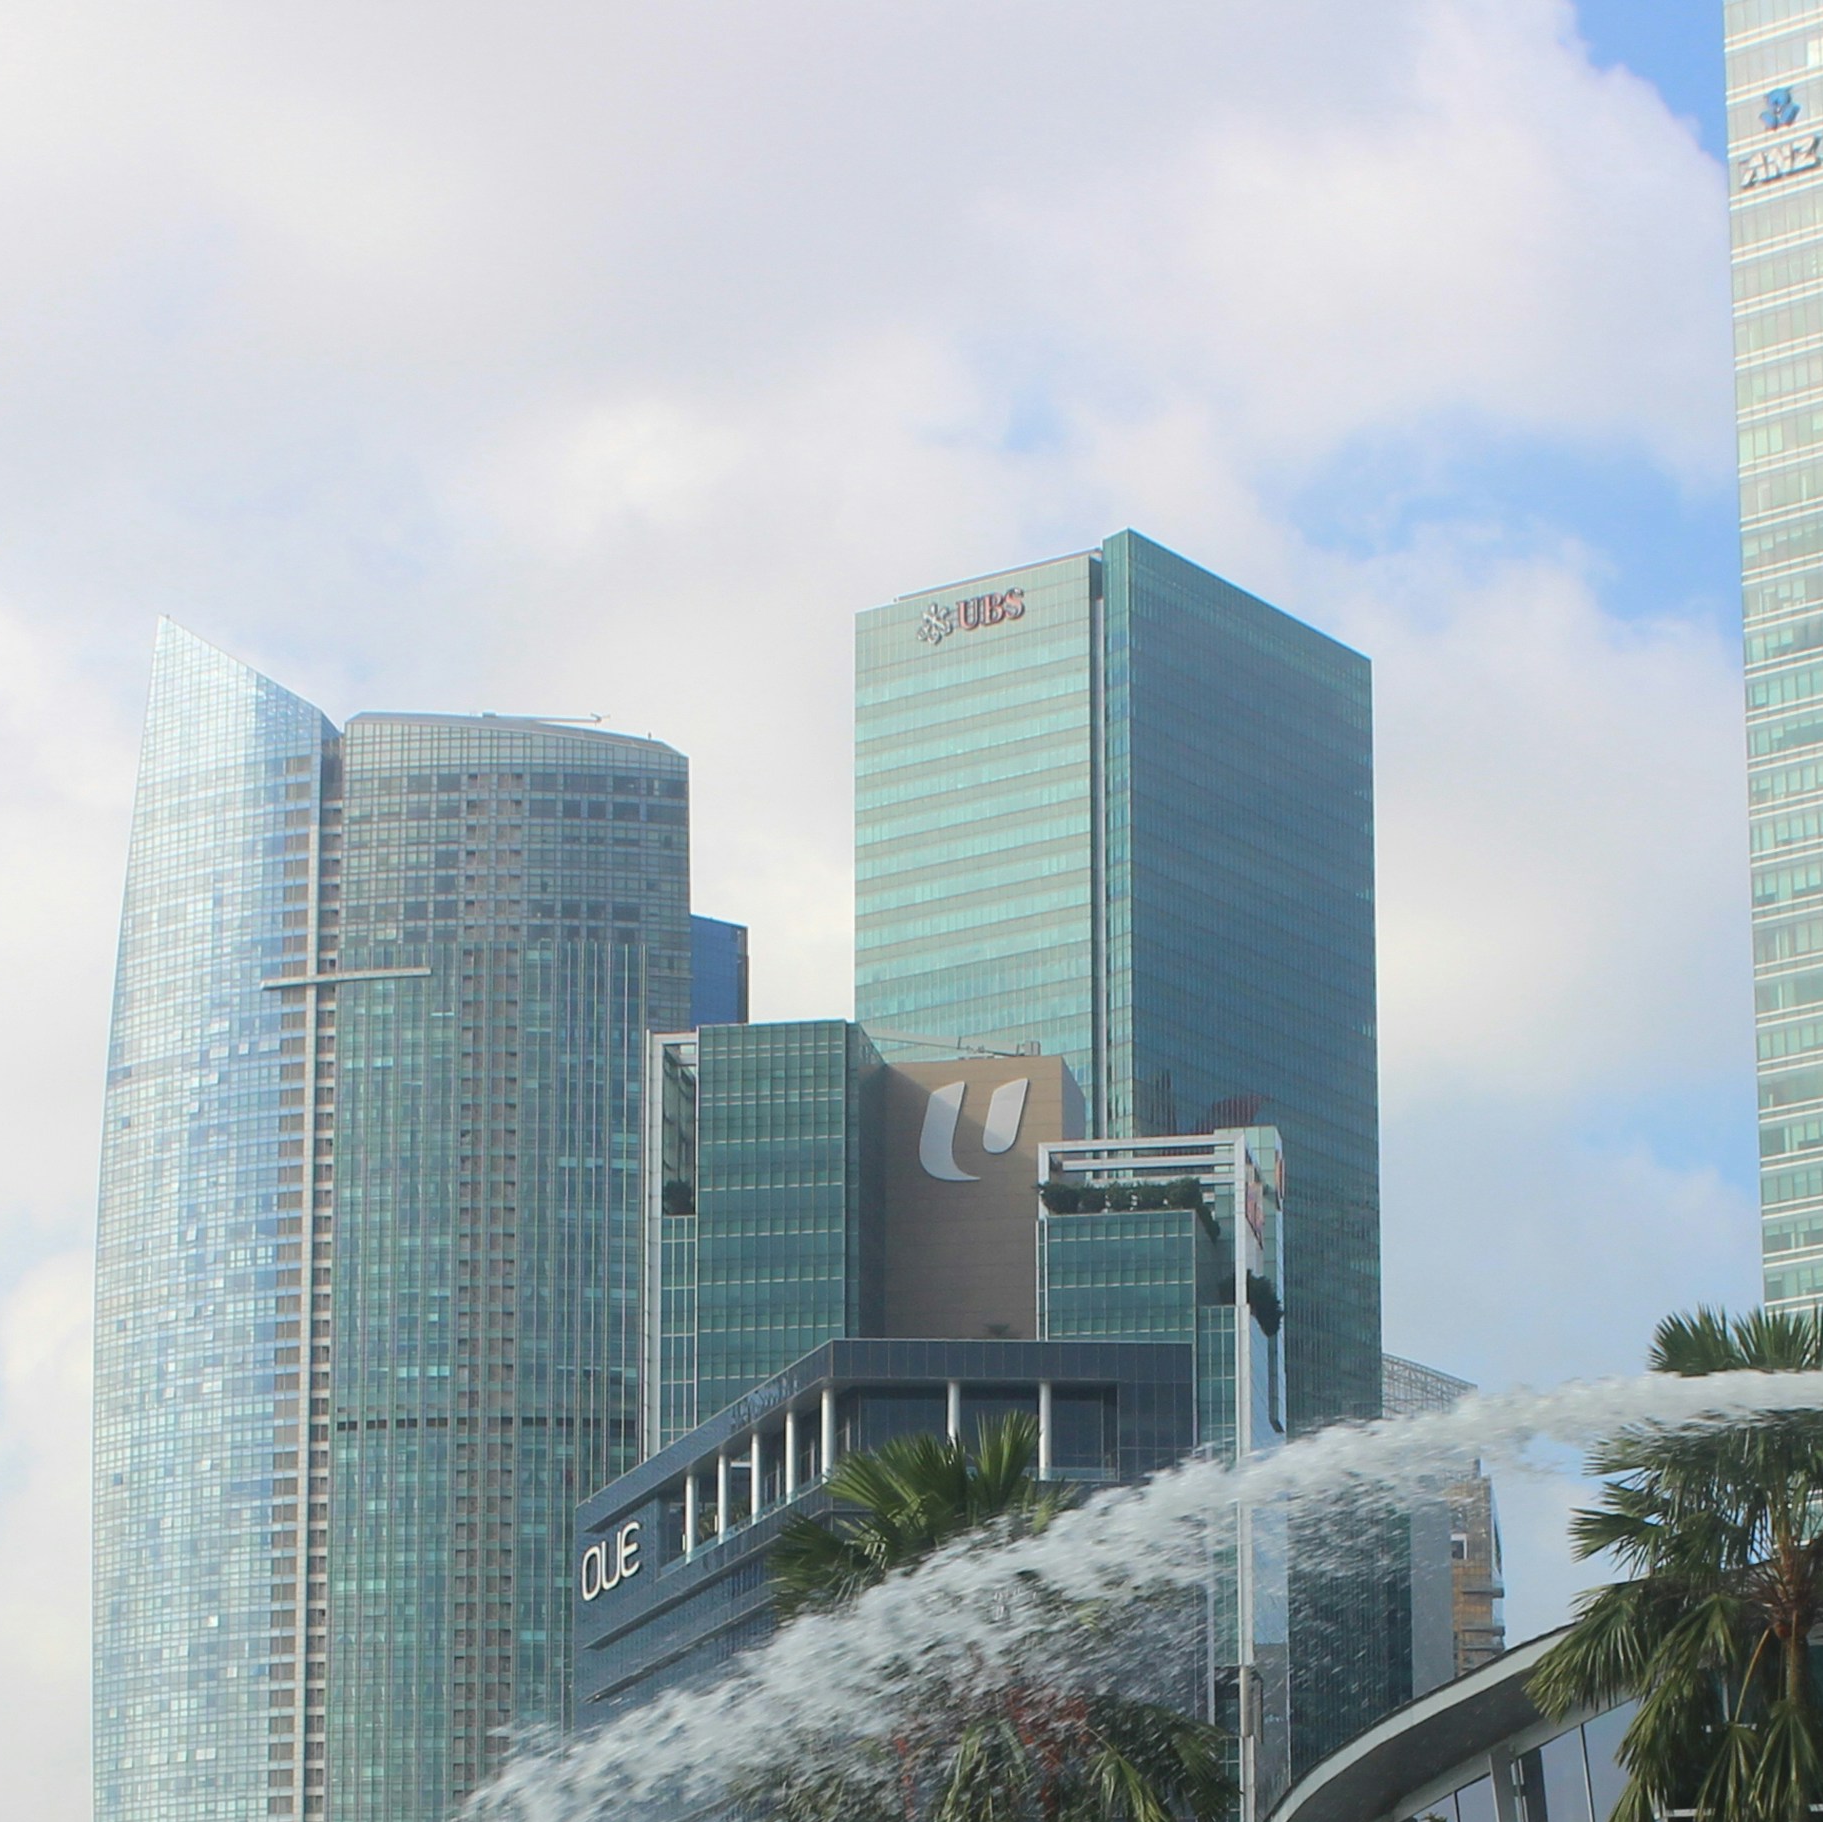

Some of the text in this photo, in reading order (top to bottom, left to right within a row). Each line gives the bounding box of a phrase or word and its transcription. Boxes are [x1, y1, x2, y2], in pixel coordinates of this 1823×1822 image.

[1739, 134, 1823, 189] ANZ
[956, 587, 1025, 631] UBS
[582, 1520, 643, 1602] OUE
